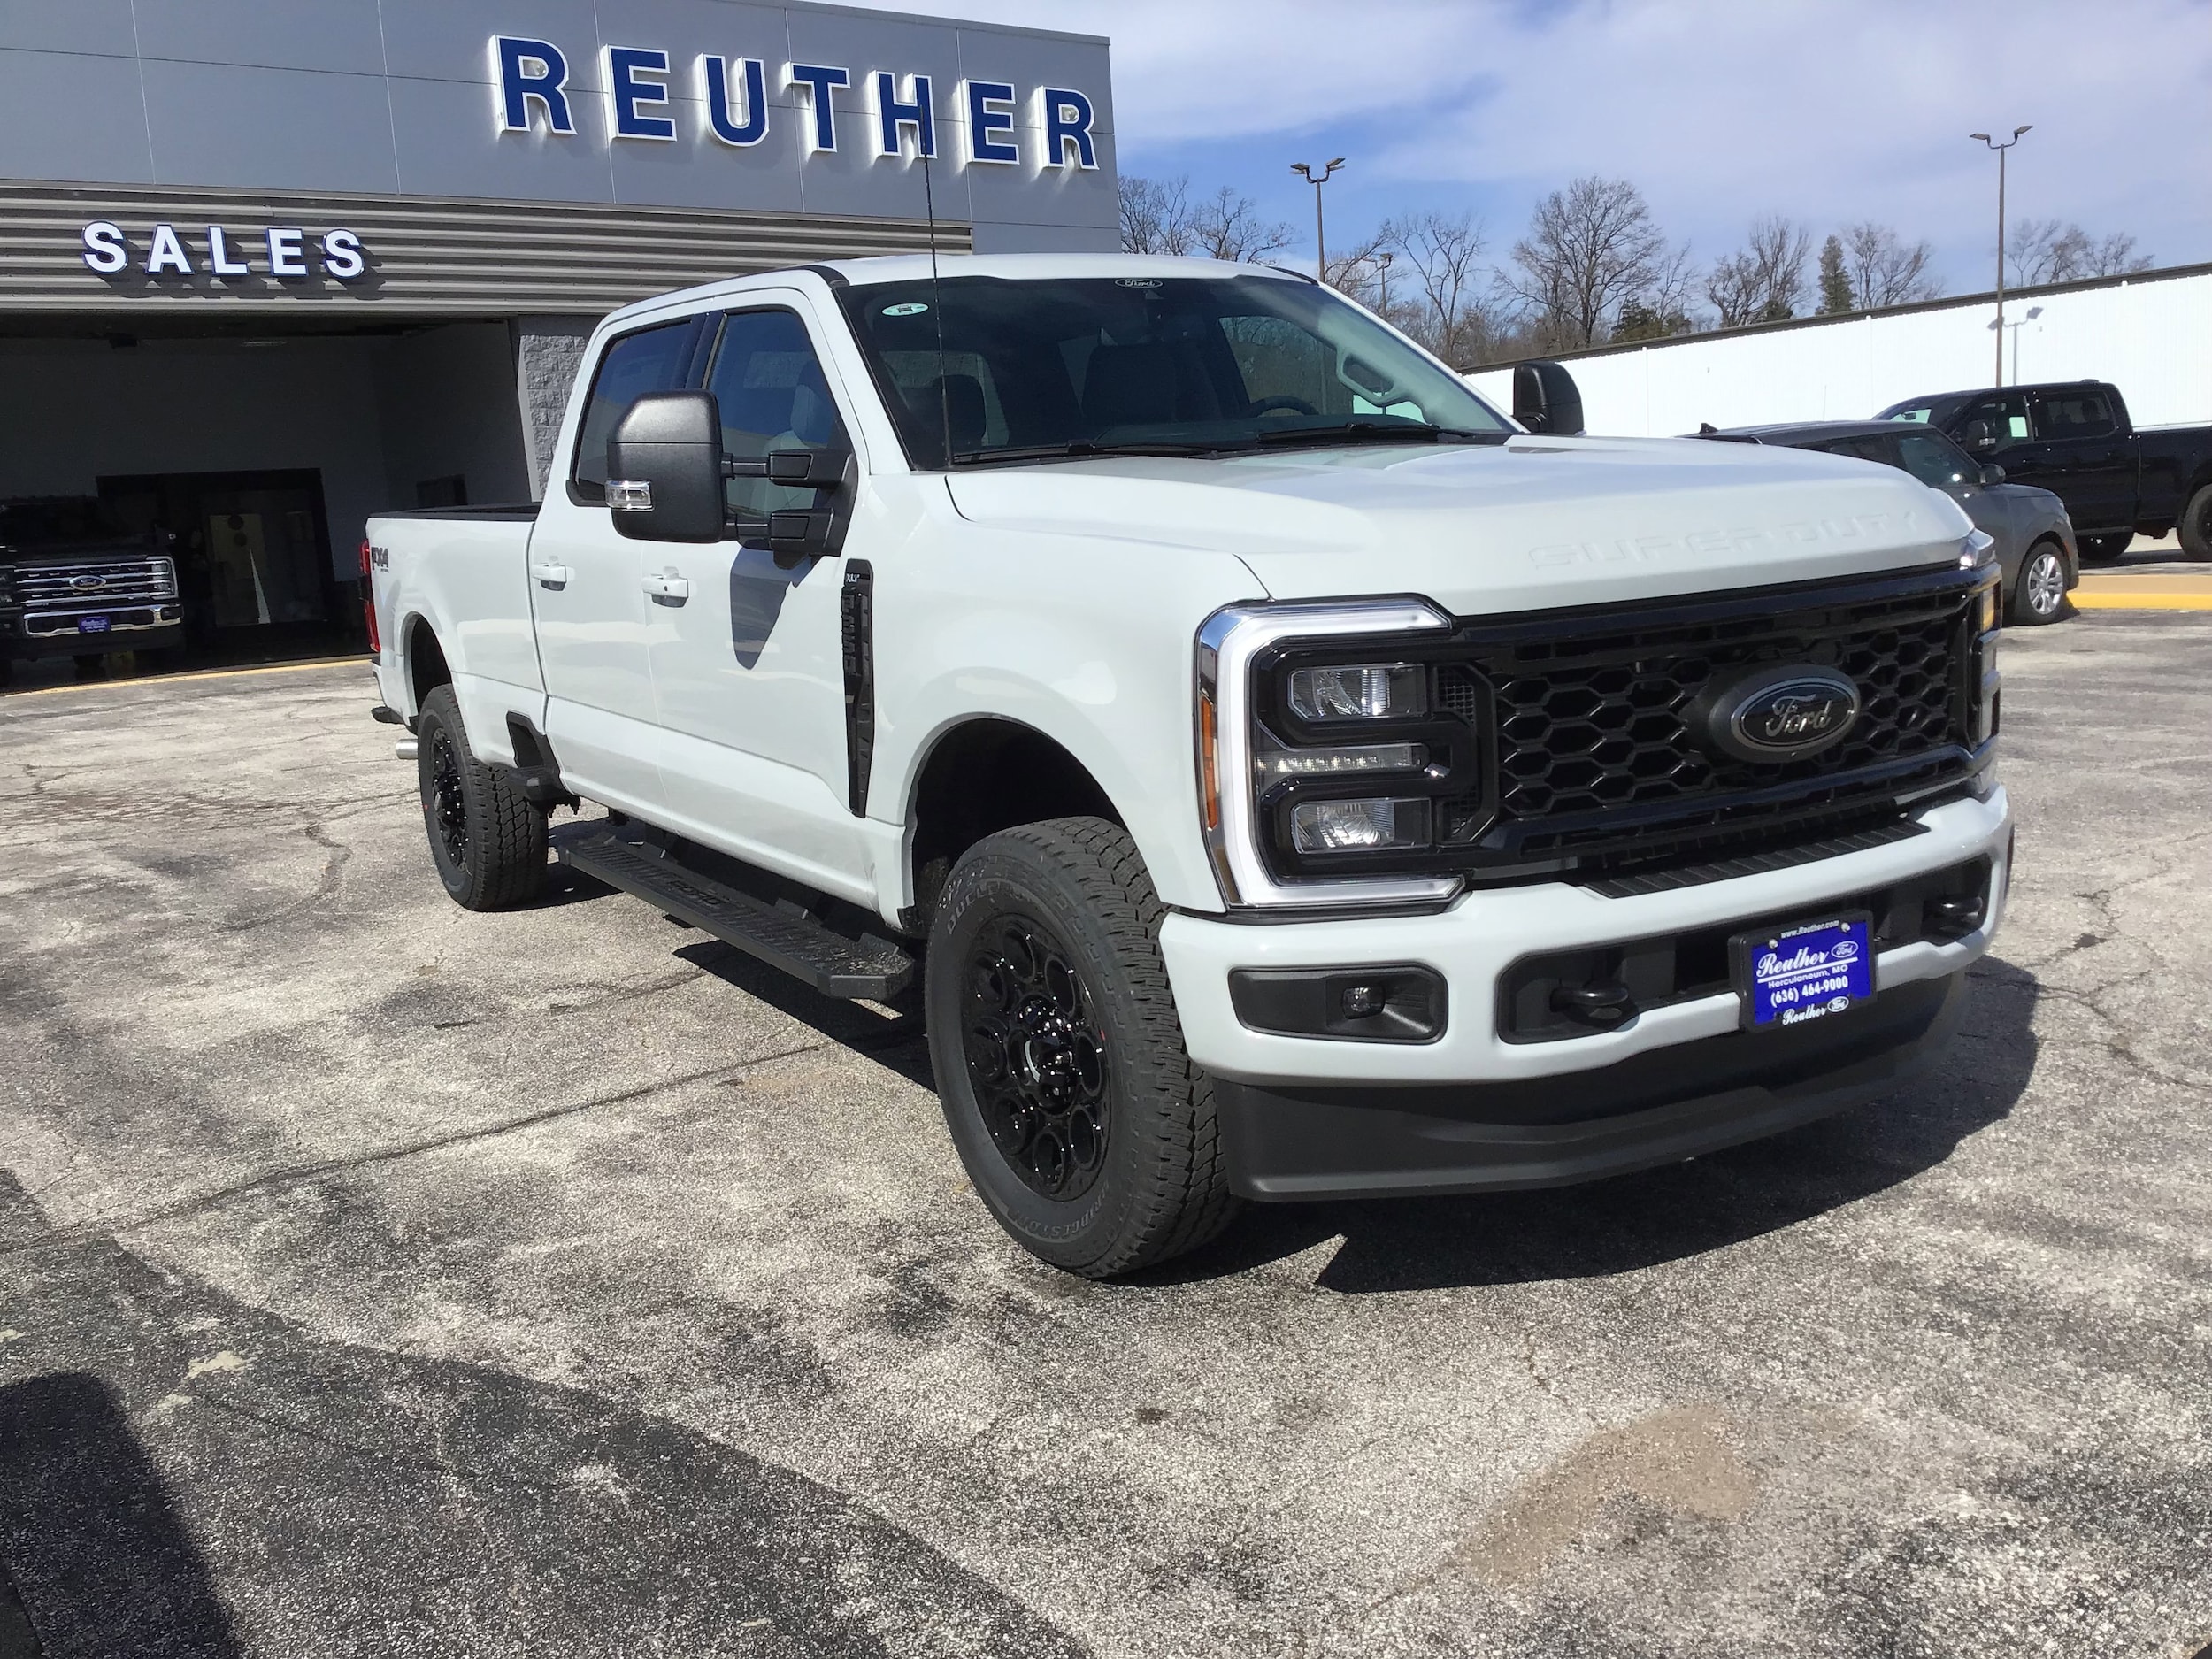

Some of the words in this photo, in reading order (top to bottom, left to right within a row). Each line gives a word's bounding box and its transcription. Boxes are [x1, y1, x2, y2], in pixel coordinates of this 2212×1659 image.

[491, 34, 1100, 171] REUTHER
[82, 219, 365, 278] SALES
[1765, 693, 1832, 737] Ford
[1780, 920, 1839, 939] www.Reuther.com
[1756, 947, 1830, 978] Reuther
[1768, 969, 1831, 989] Herculaneum,
[1832, 964, 1848, 974] MO
[1770, 988, 1800, 1008] (636)
[1801, 975, 1848, 997] 464-9000
[1782, 1003, 1828, 1025] Reuther
